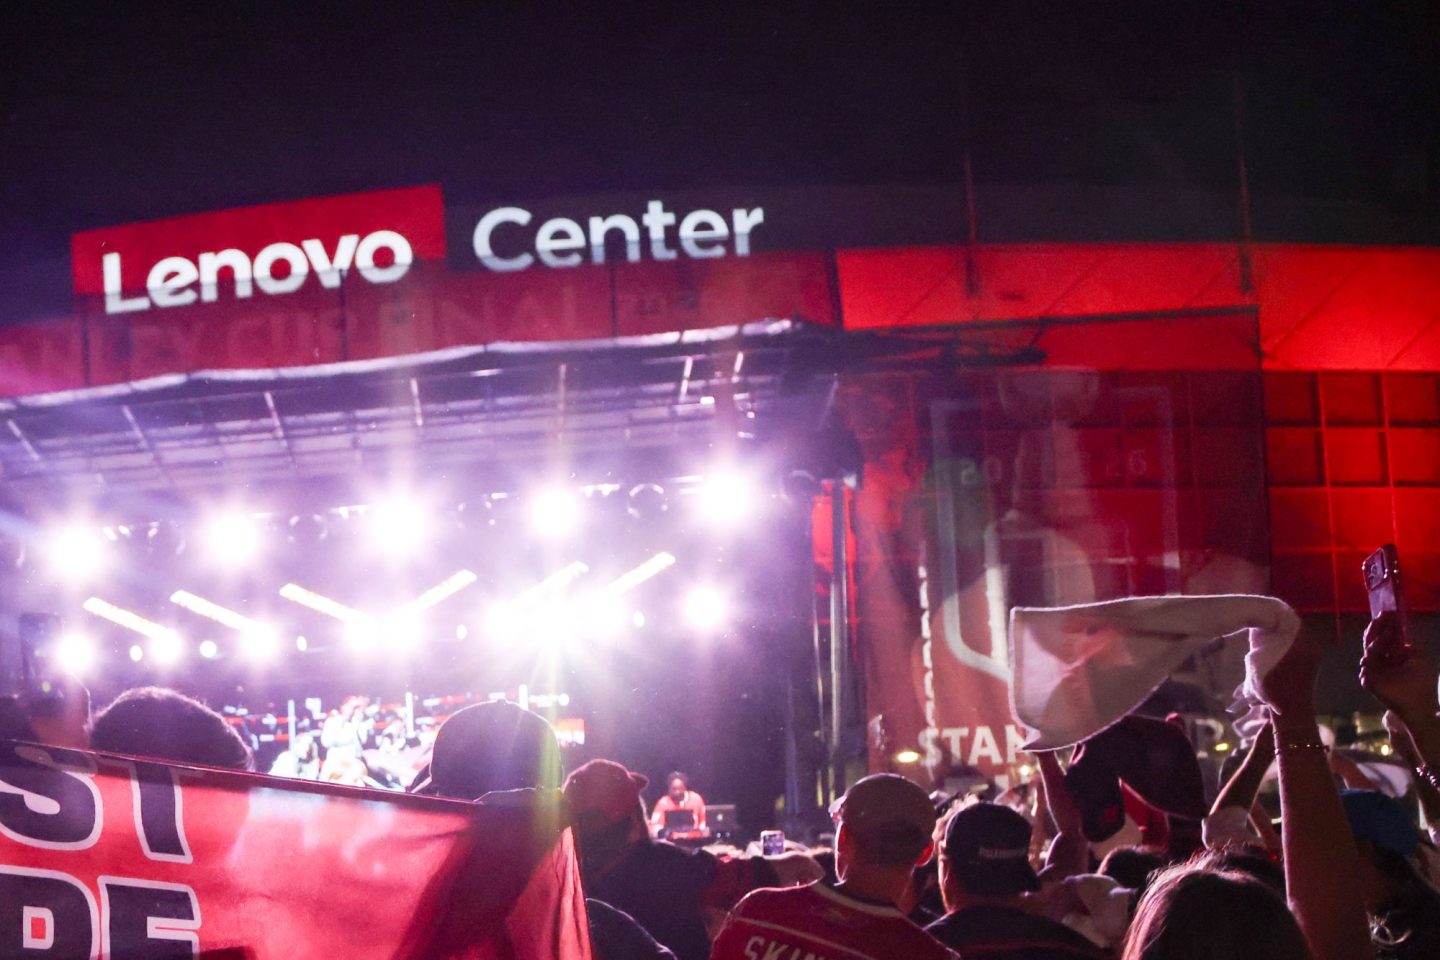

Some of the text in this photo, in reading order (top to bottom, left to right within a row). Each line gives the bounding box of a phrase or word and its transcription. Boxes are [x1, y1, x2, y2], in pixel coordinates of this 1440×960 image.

[101, 199, 765, 315] Lenovo Center
[917, 723, 1026, 767] STAN
